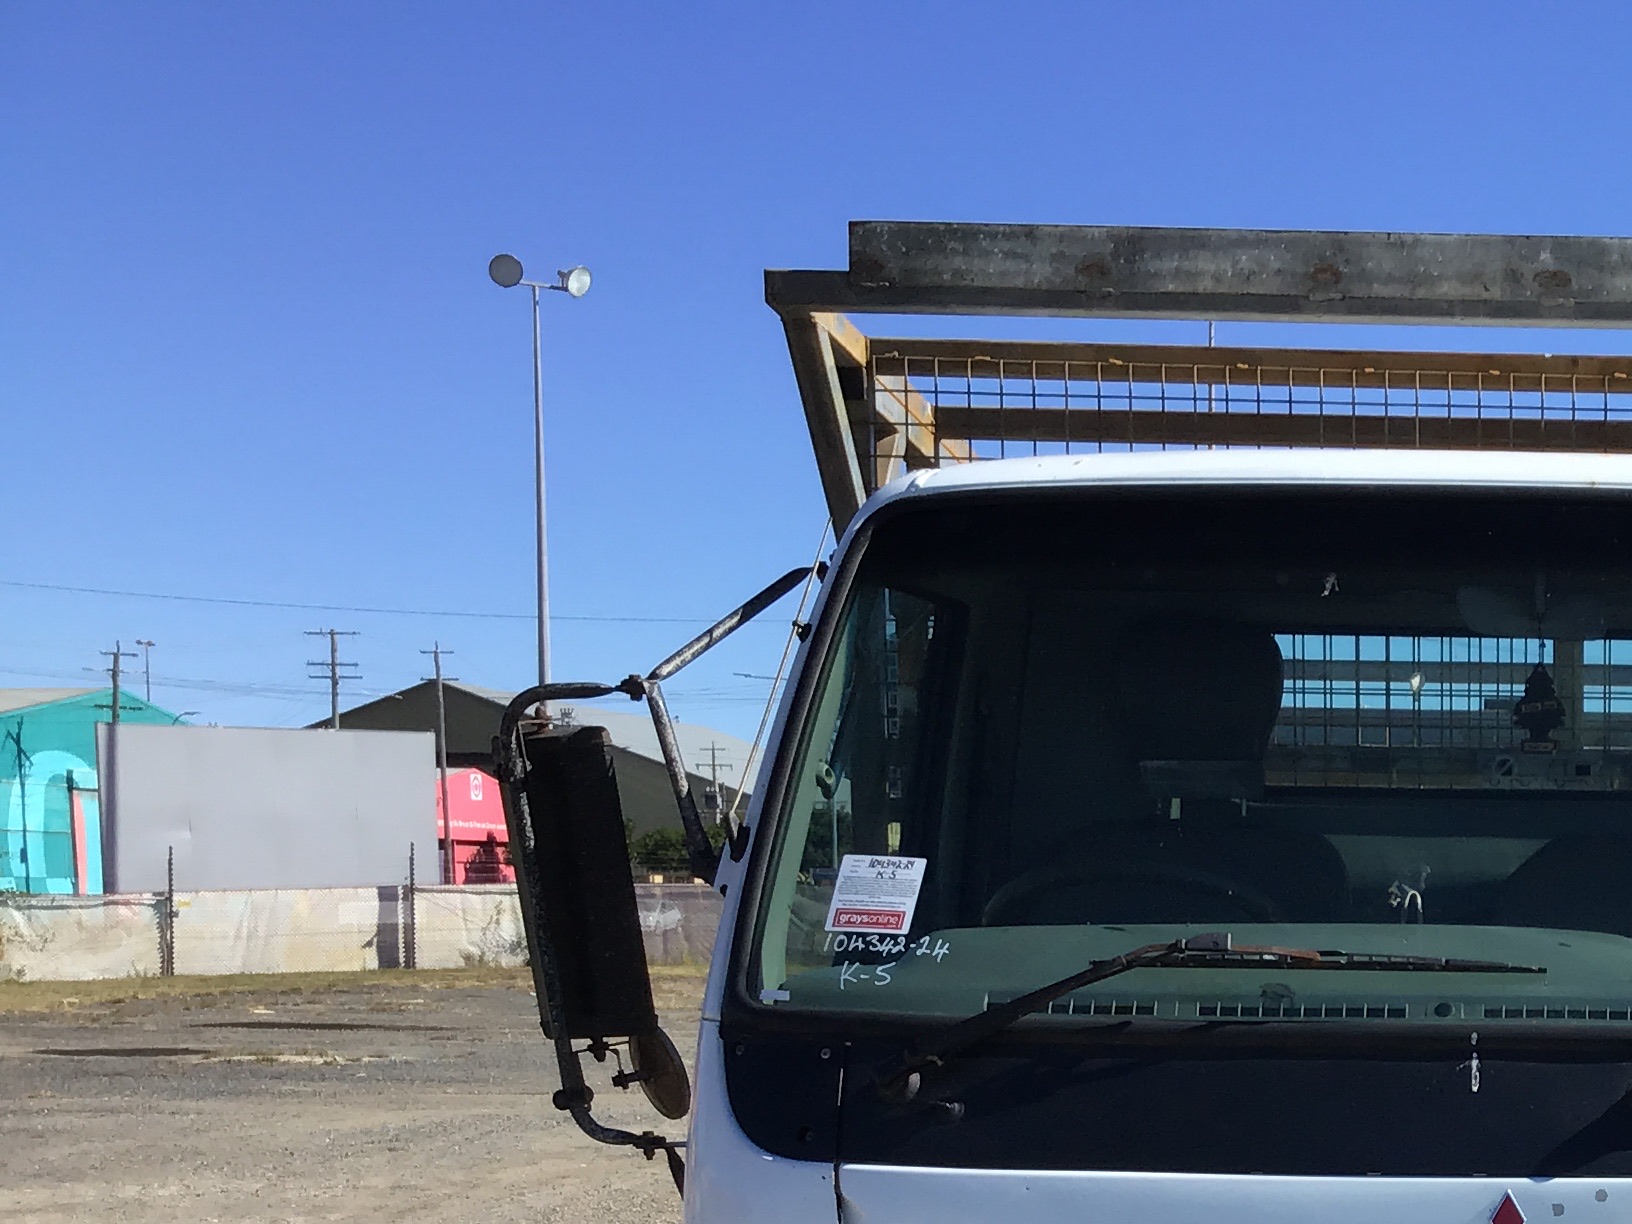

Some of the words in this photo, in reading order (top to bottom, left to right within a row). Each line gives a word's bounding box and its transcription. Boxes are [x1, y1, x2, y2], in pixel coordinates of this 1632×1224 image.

[839, 913, 899, 924] graysonline
[823, 932, 950, 963] 104342-24
[839, 960, 897, 990] K-5
